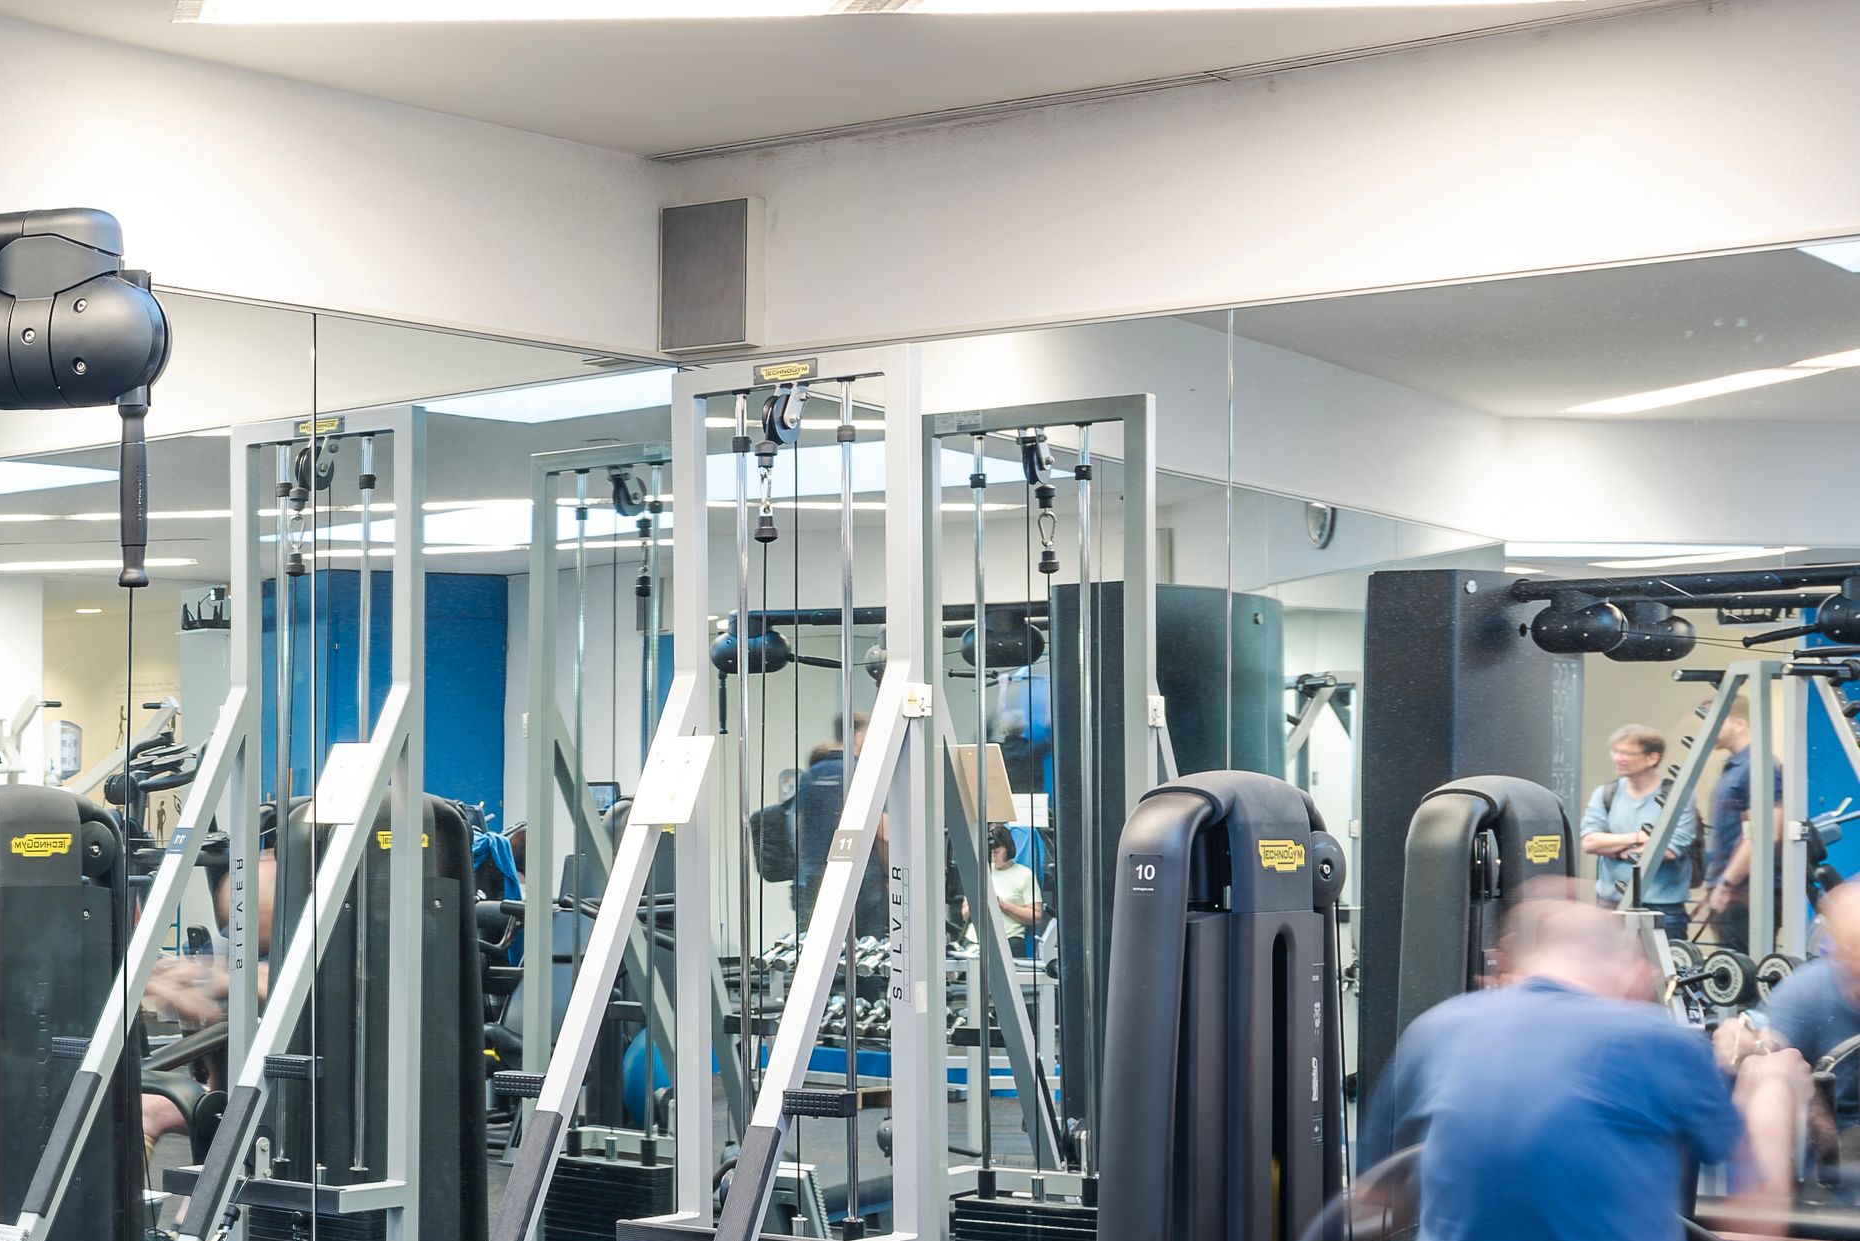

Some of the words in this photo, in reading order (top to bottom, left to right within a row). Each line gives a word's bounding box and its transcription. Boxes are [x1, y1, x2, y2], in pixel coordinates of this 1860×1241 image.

[838, 837, 853, 850] 11
[1261, 846, 1303, 862] TECHNOGYM
[1135, 863, 1156, 881] 10
[892, 866, 902, 1000] SILVER
